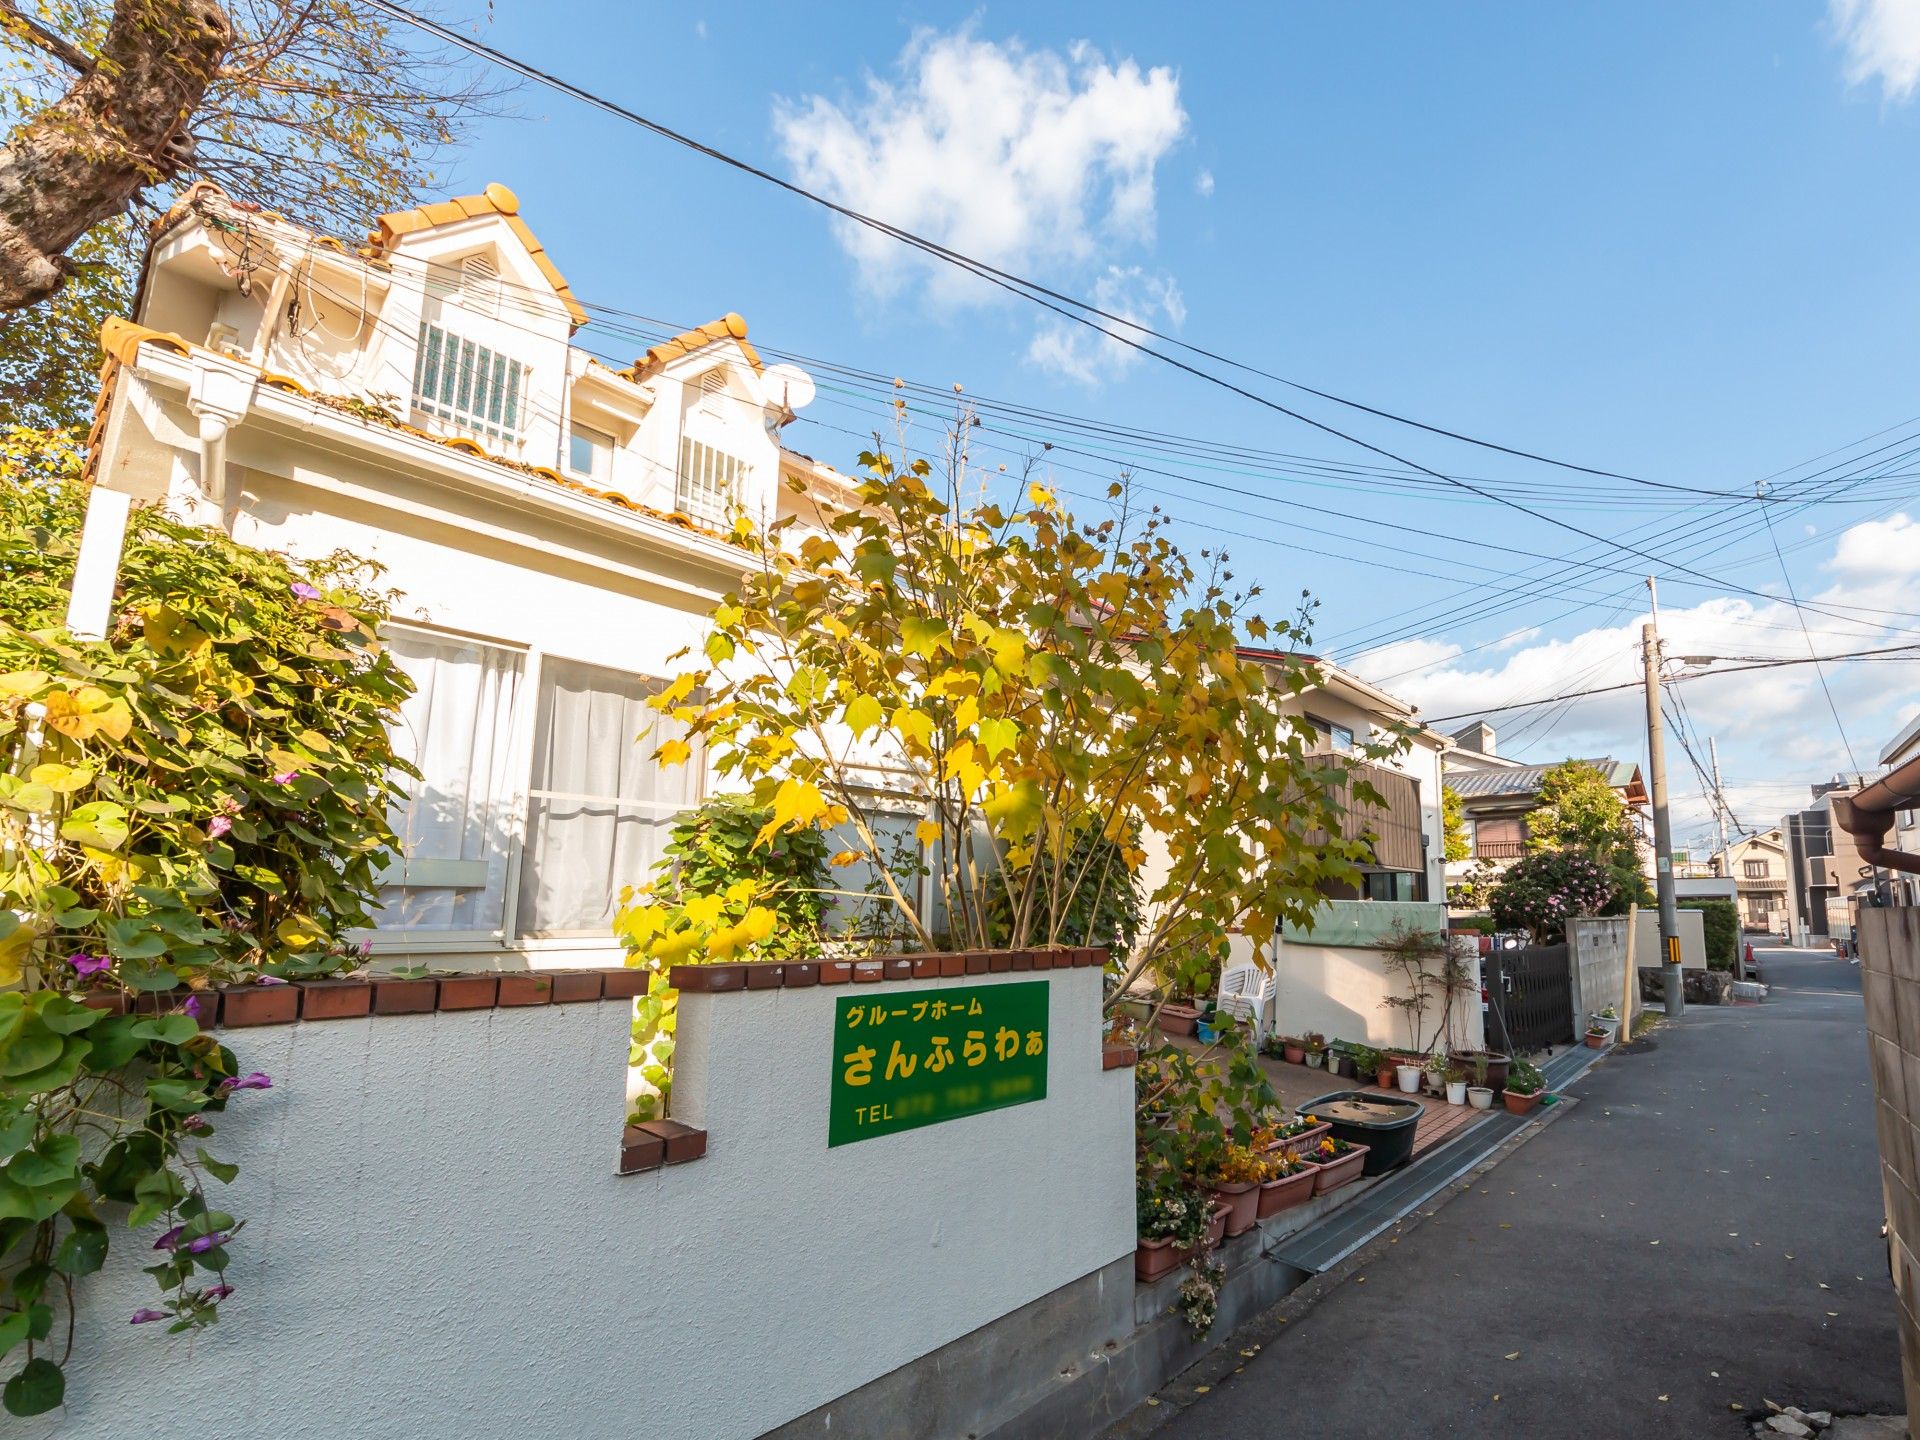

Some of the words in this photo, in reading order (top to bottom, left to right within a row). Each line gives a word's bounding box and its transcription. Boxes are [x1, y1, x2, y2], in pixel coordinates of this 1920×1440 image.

[846, 998, 983, 1028] グループホーム
[843, 1026, 1044, 1086] さんふらわぁ
[856, 1103, 893, 1125] TEL
